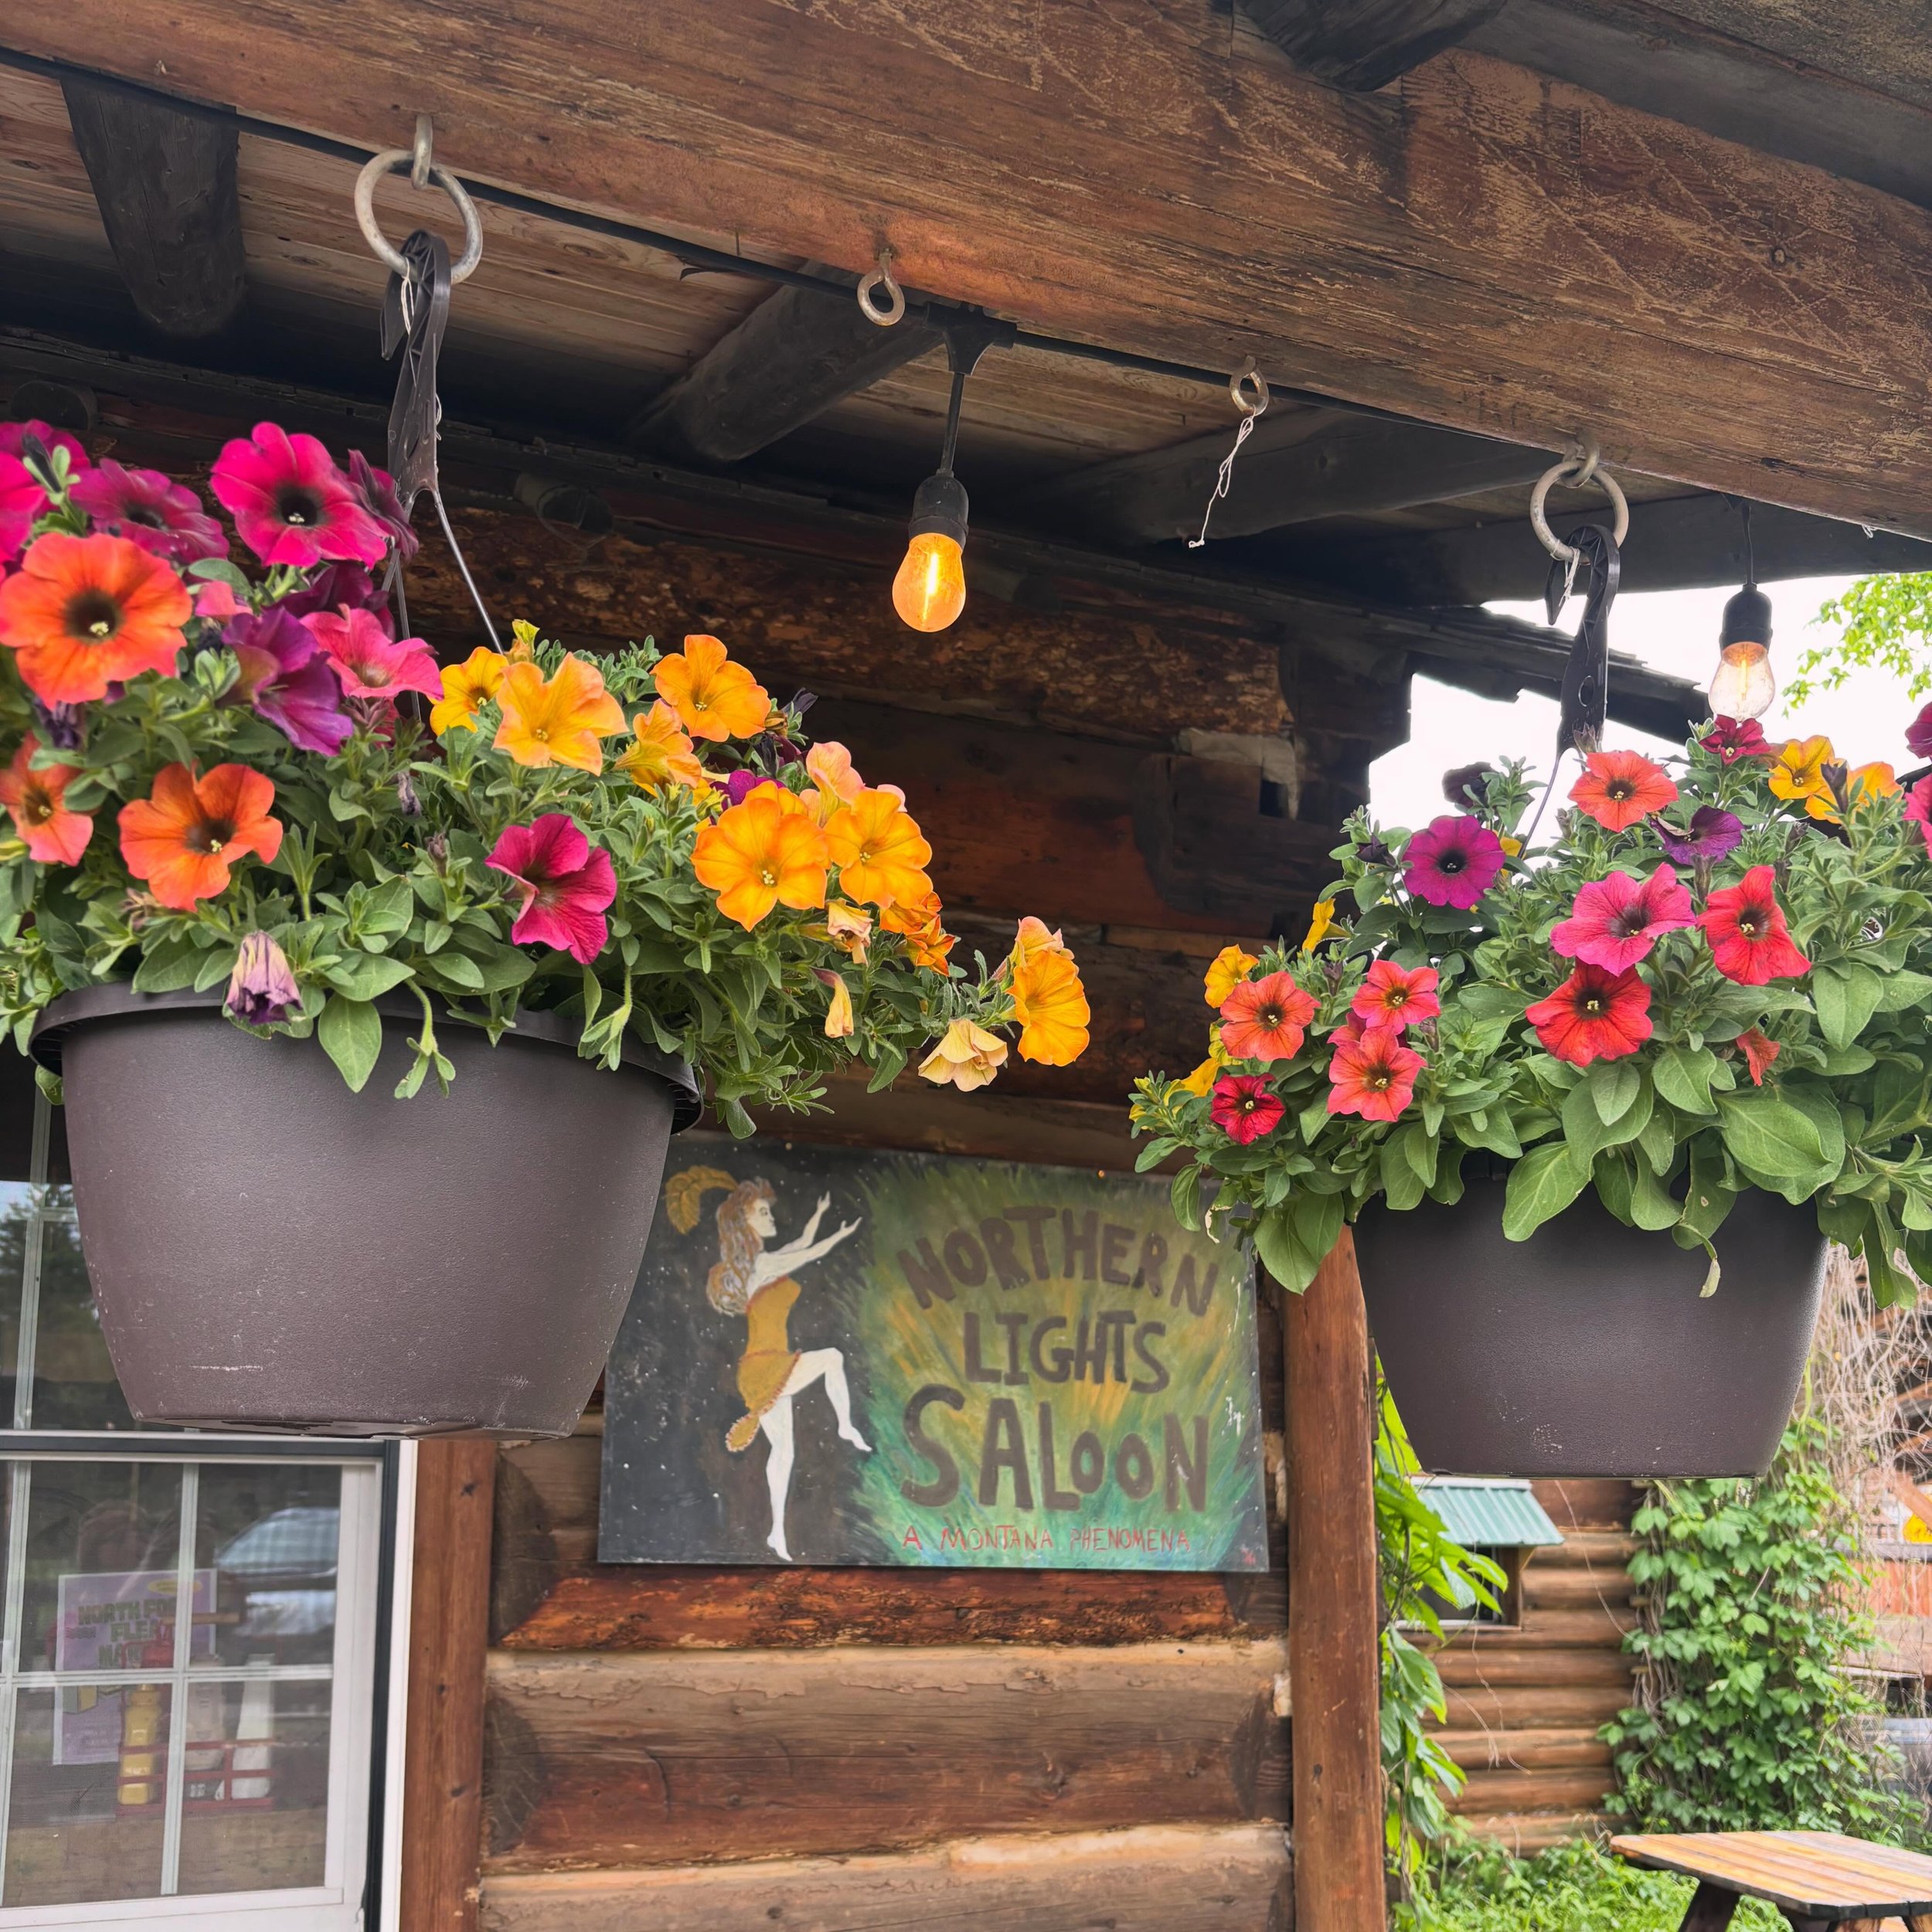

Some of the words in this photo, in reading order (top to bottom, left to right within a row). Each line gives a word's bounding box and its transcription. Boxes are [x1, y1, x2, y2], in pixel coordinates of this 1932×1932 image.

[896, 1206, 1219, 1317] NORTHERN
[963, 1310, 1171, 1393] LIGHTS
[900, 1383, 1209, 1512] SALOON
[902, 1525, 923, 1551] A
[940, 1524, 1054, 1552] MONTANA
[1069, 1526, 1192, 1553] PHENOMENA
[78, 1600, 141, 1625] NORTH
